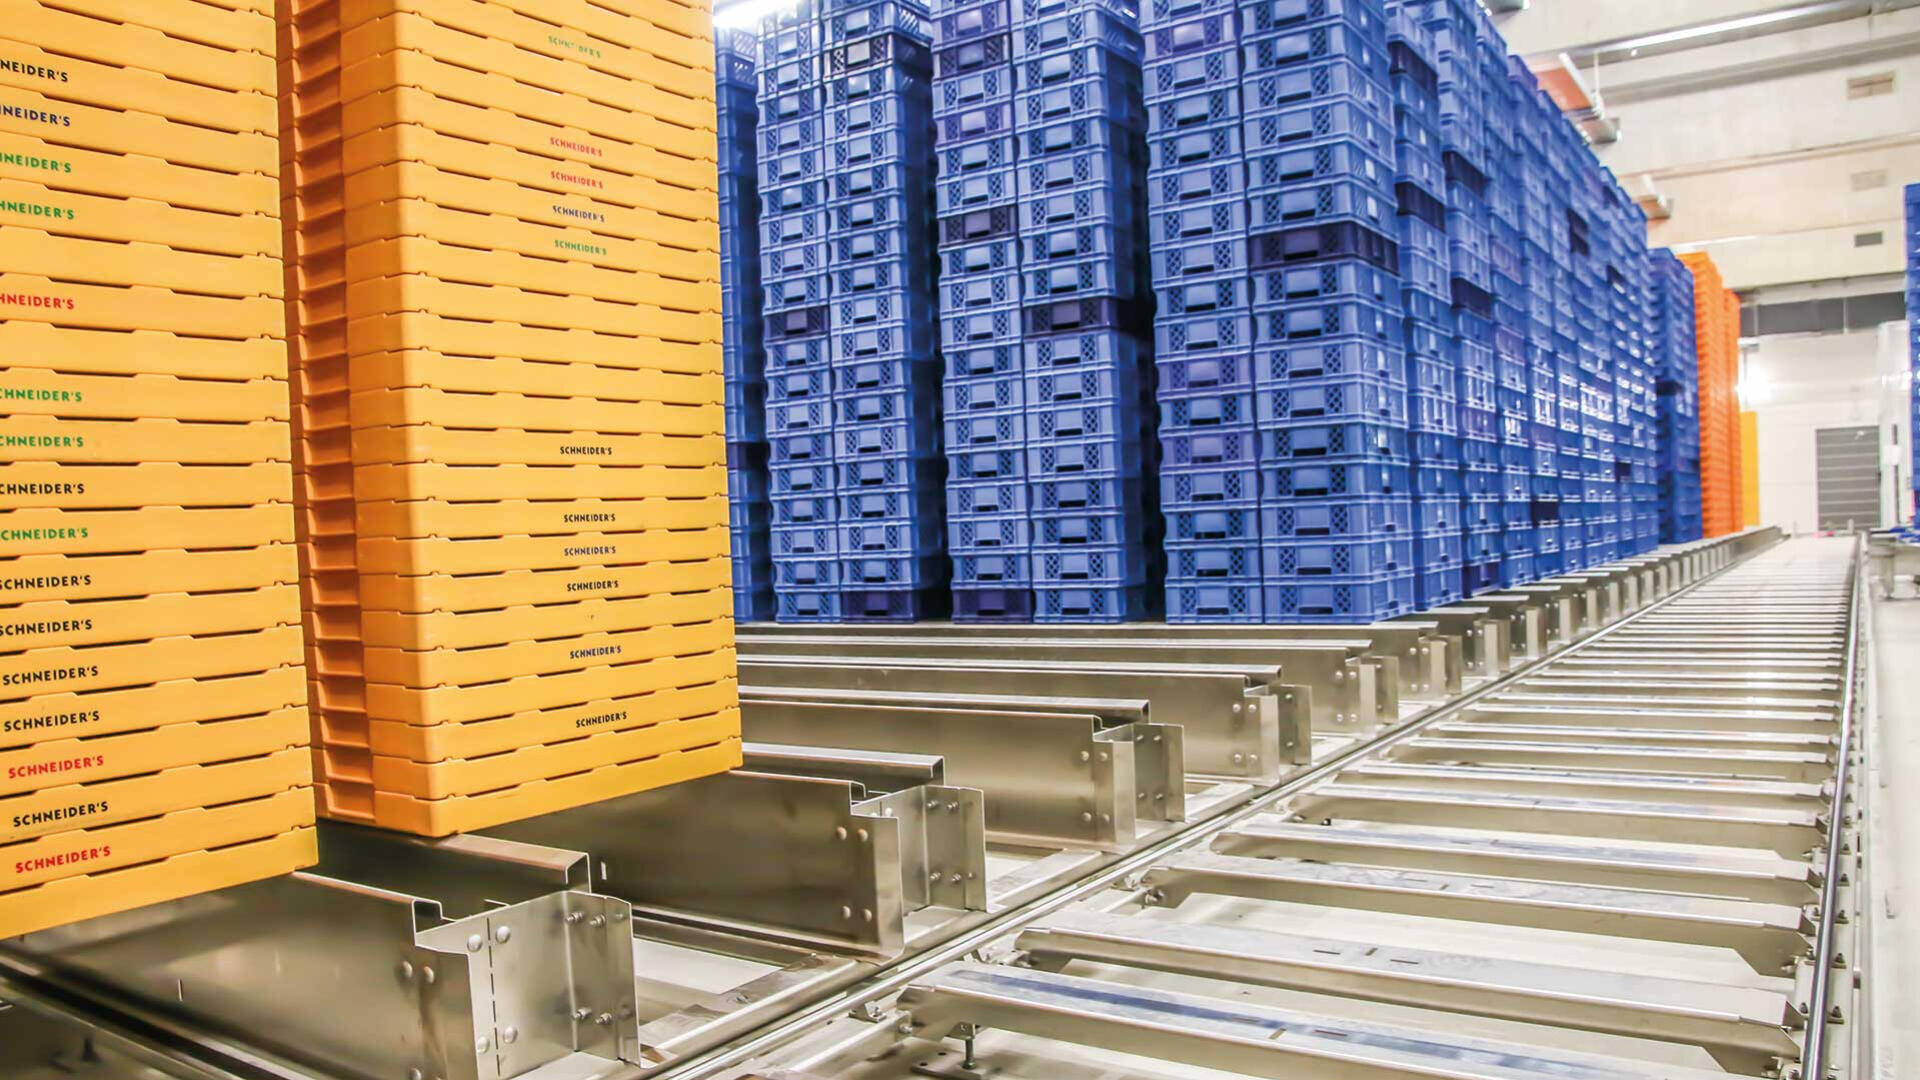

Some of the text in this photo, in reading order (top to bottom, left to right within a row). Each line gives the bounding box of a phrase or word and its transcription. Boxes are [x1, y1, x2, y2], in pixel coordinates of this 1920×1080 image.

[0, 104, 70, 127] NEIDER'S
[550, 137, 602, 156] SCHNEIDER'S
[0, 152, 72, 173] NEIDER'S
[551, 171, 603, 189] SCHNEIDER'S
[555, 240, 607, 256] SCHNEIDER'S
[560, 446, 612, 455] SCHNEIDER'S
[564, 513, 616, 523] SCHNEIDER'S
[564, 546, 616, 556] SCHNEIDER'S
[567, 580, 619, 592] SCHNEIDER'S
[570, 645, 621, 659] SCHNEIDER'S
[2, 666, 98, 686] SCHNEIDER'S
[4, 710, 99, 732] SCHNEIDER'S
[576, 711, 627, 728] SCHNEIDER'S
[8, 755, 104, 779] SCHNEIDER'S
[13, 801, 108, 827] SCHNEIDER'S
[16, 846, 110, 873] SCHNEIDER'S
